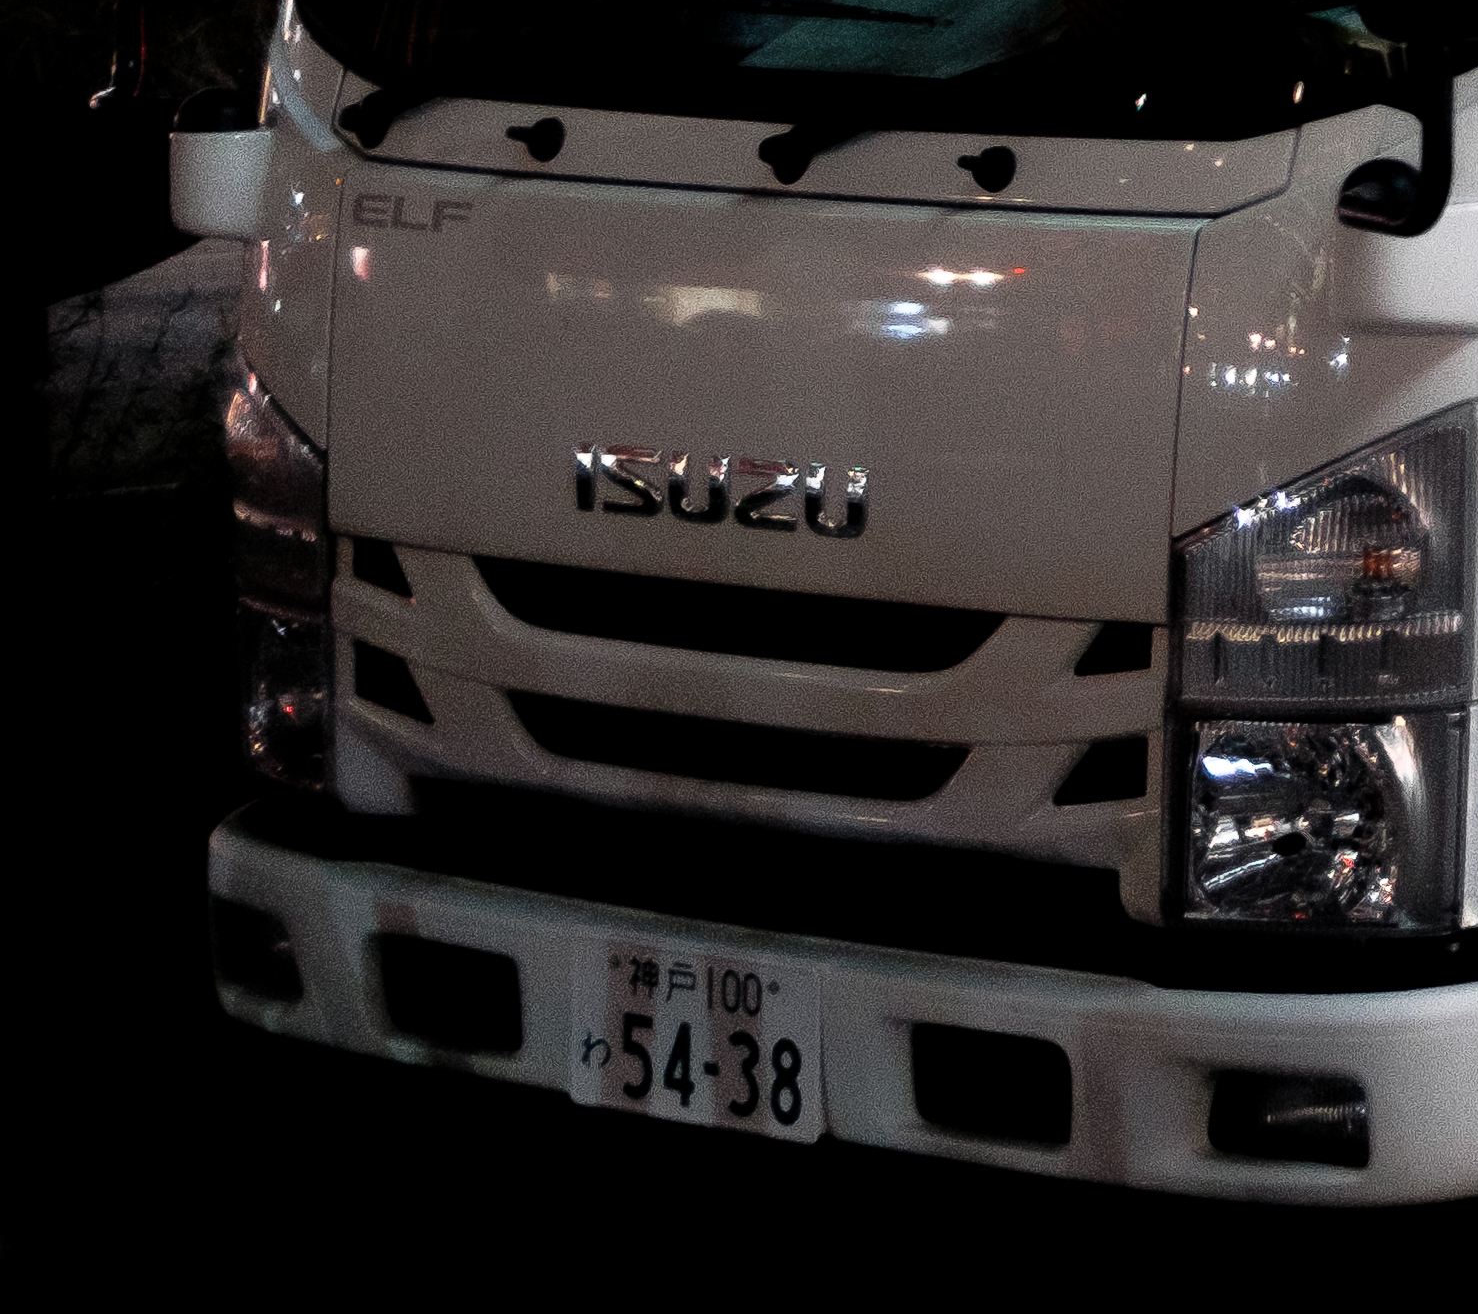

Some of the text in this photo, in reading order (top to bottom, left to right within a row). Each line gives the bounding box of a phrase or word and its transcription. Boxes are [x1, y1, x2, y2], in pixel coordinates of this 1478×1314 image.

[352, 193, 474, 232] ELF
[573, 443, 869, 539] ISUZU
[629, 957, 762, 1016] 神戸 100
[582, 1012, 801, 1126] わ 54-38
